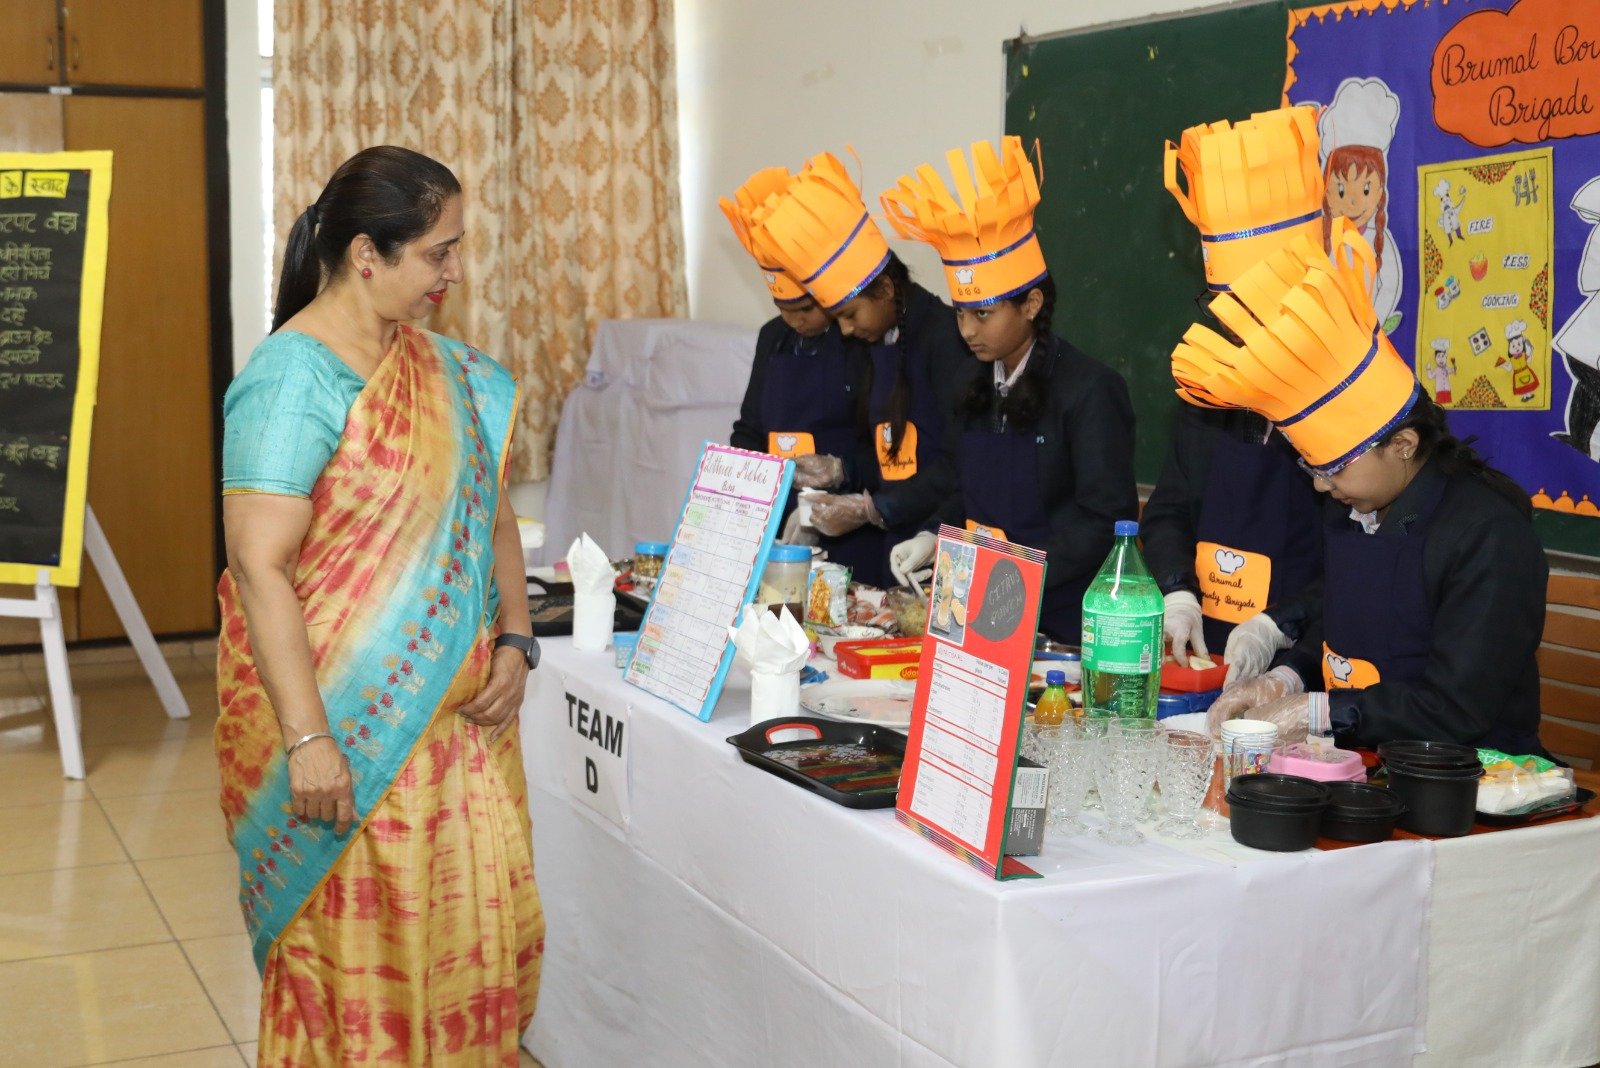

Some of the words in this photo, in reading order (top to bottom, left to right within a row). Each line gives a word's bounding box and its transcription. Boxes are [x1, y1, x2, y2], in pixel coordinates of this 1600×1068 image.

[1441, 33, 1539, 86] Brumal
[1489, 78, 1594, 141] Brigade
[0, 212, 37, 233] टपट
[1469, 219, 1491, 232] FIRE
[1504, 255, 1528, 268] LESS
[1482, 295, 1517, 307] COOKING
[989, 569, 1020, 606] CITRUS
[1208, 571, 1242, 588] Brumal
[1224, 594, 1256, 612] Brigade
[565, 691, 624, 758] TEAM
[585, 755, 599, 794] D
